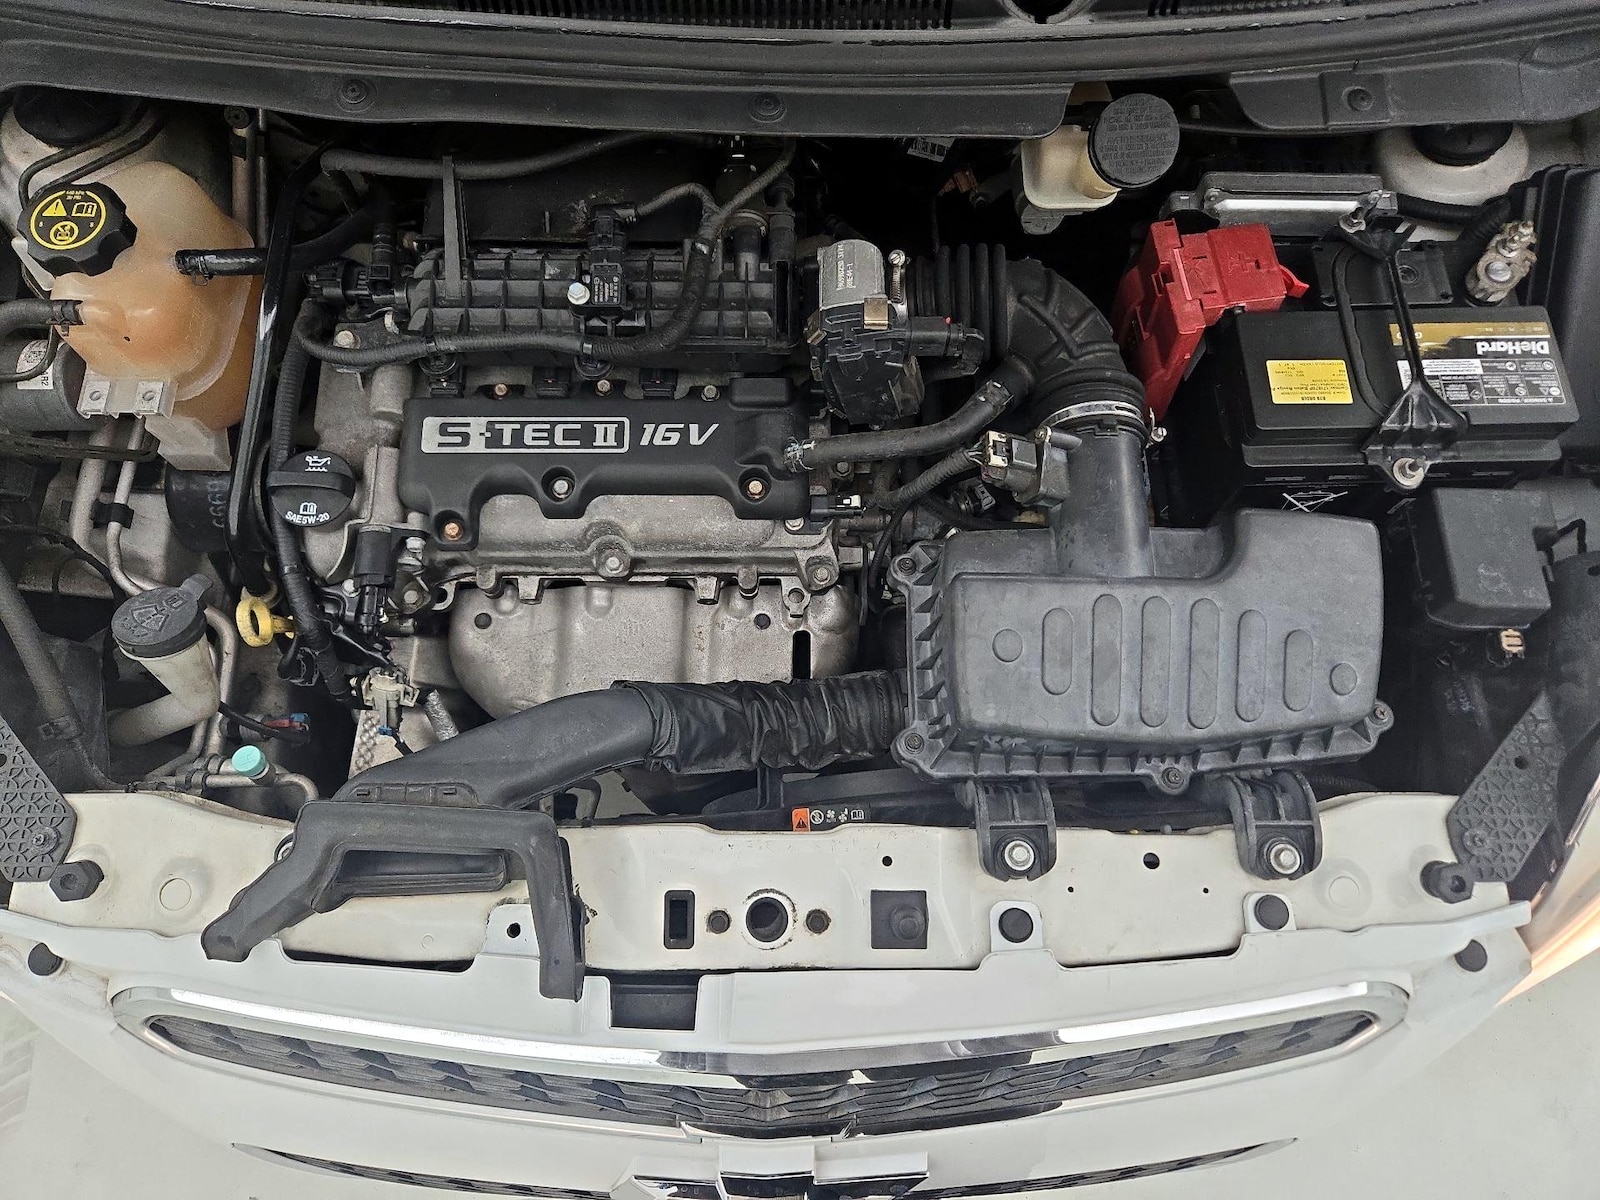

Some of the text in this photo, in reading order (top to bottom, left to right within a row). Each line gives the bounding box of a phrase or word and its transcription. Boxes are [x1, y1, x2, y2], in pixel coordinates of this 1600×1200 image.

[1475, 340, 1550, 356] DieHard
[639, 423, 720, 446] 16V
[285, 510, 330, 525] SAE5W-20
